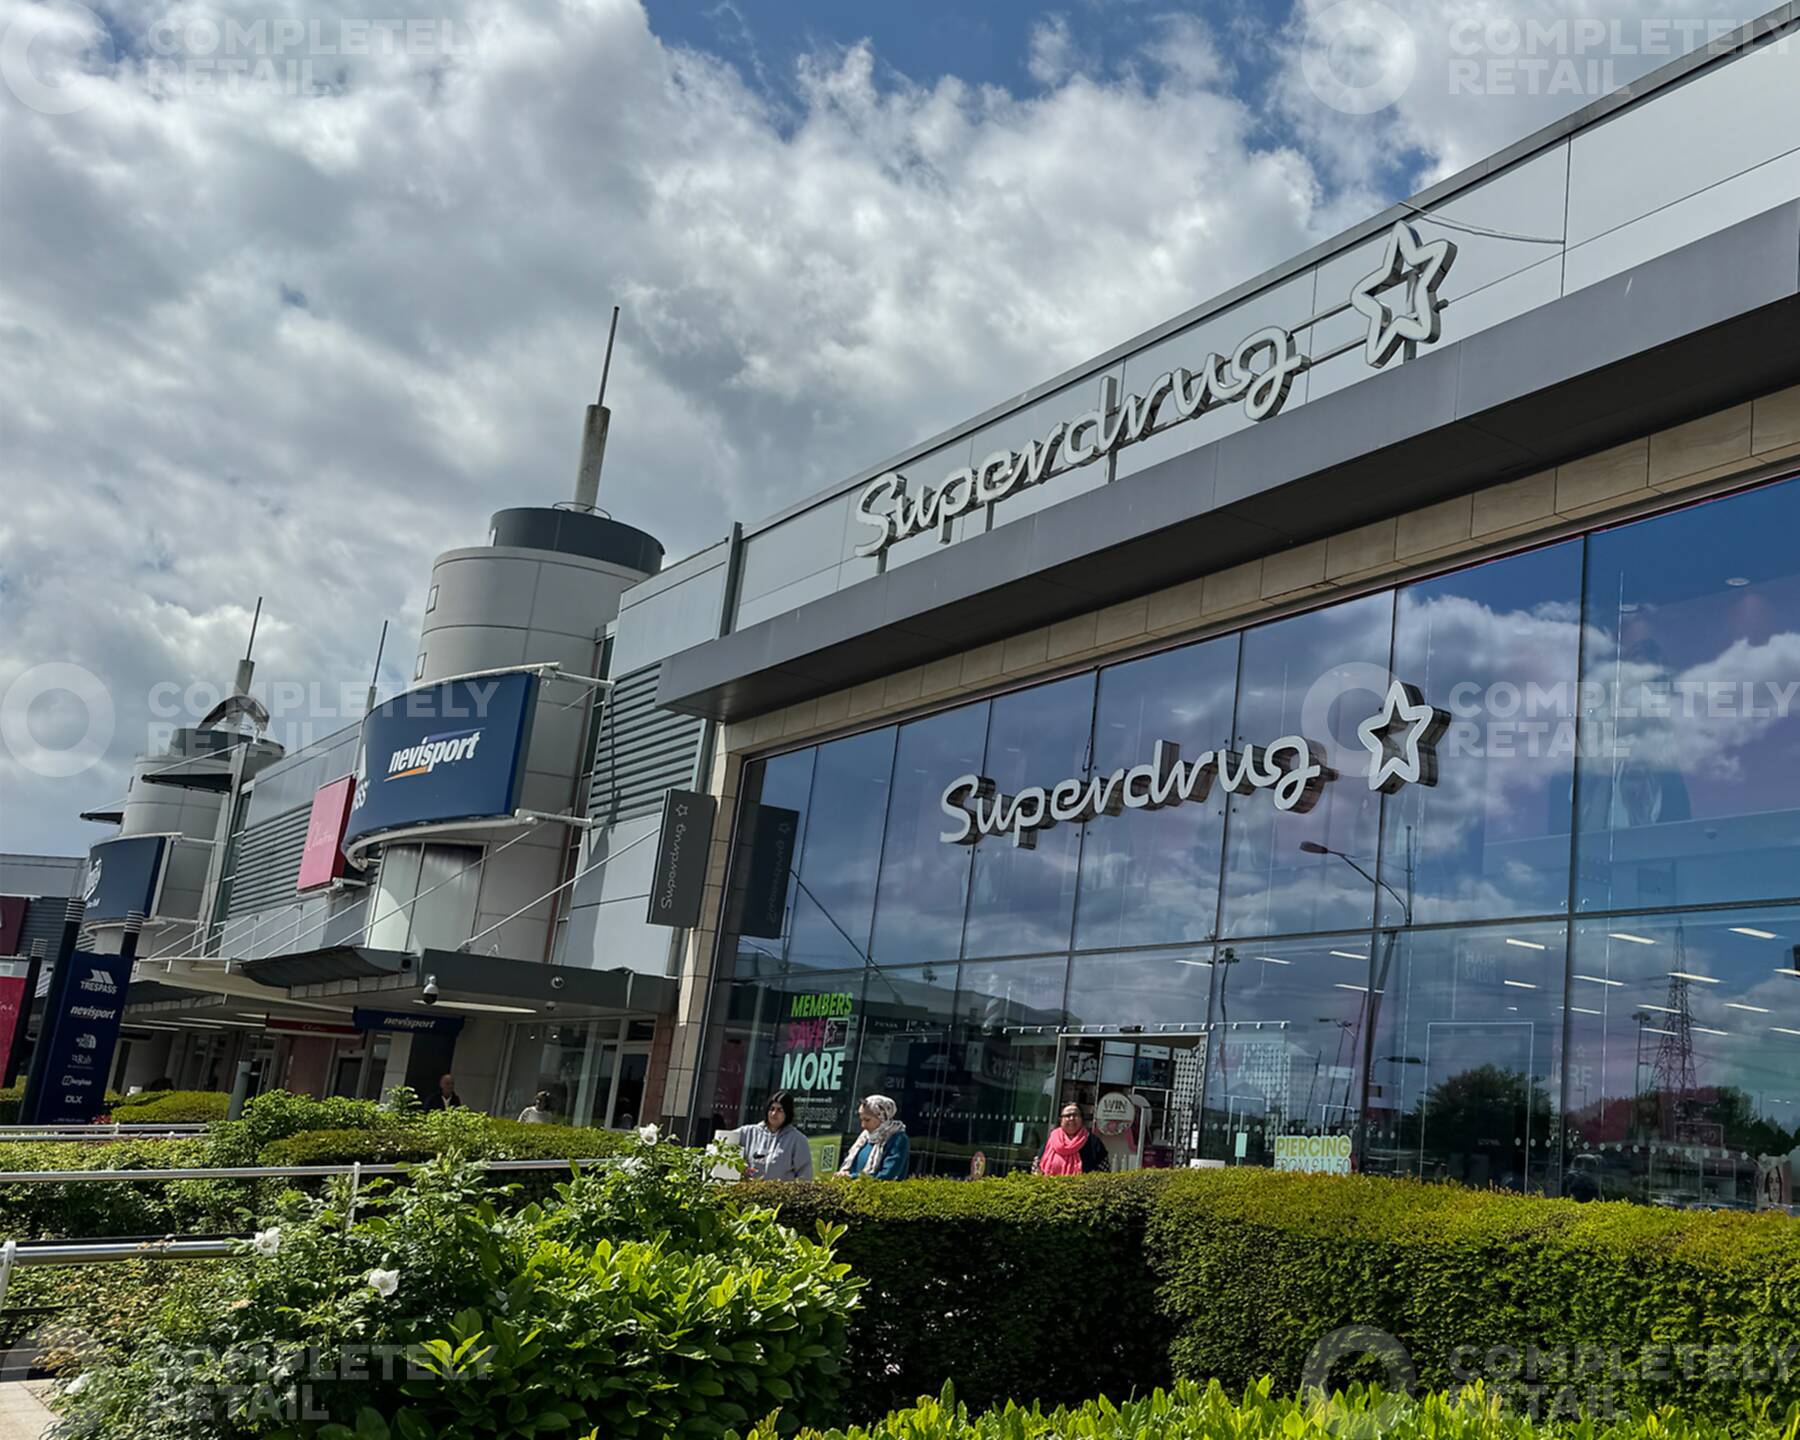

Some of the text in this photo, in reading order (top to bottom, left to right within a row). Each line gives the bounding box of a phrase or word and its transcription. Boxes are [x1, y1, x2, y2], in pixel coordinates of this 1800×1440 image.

[853, 325, 1311, 558] Superdrug
[388, 731, 481, 773] nevisport
[940, 735, 1338, 850] Superdrug
[660, 823, 687, 910] Superdrug
[80, 980, 118, 995] TRESPASS
[70, 1005, 116, 1020] nevisport
[790, 991, 853, 1017] MEMBERS
[383, 1016, 435, 1029] nevisport
[780, 1052, 846, 1091] MORE
[64, 1095, 83, 1104] DLX
[1103, 1099, 1128, 1110] WIN
[1275, 1136, 1352, 1158] PIERCING
